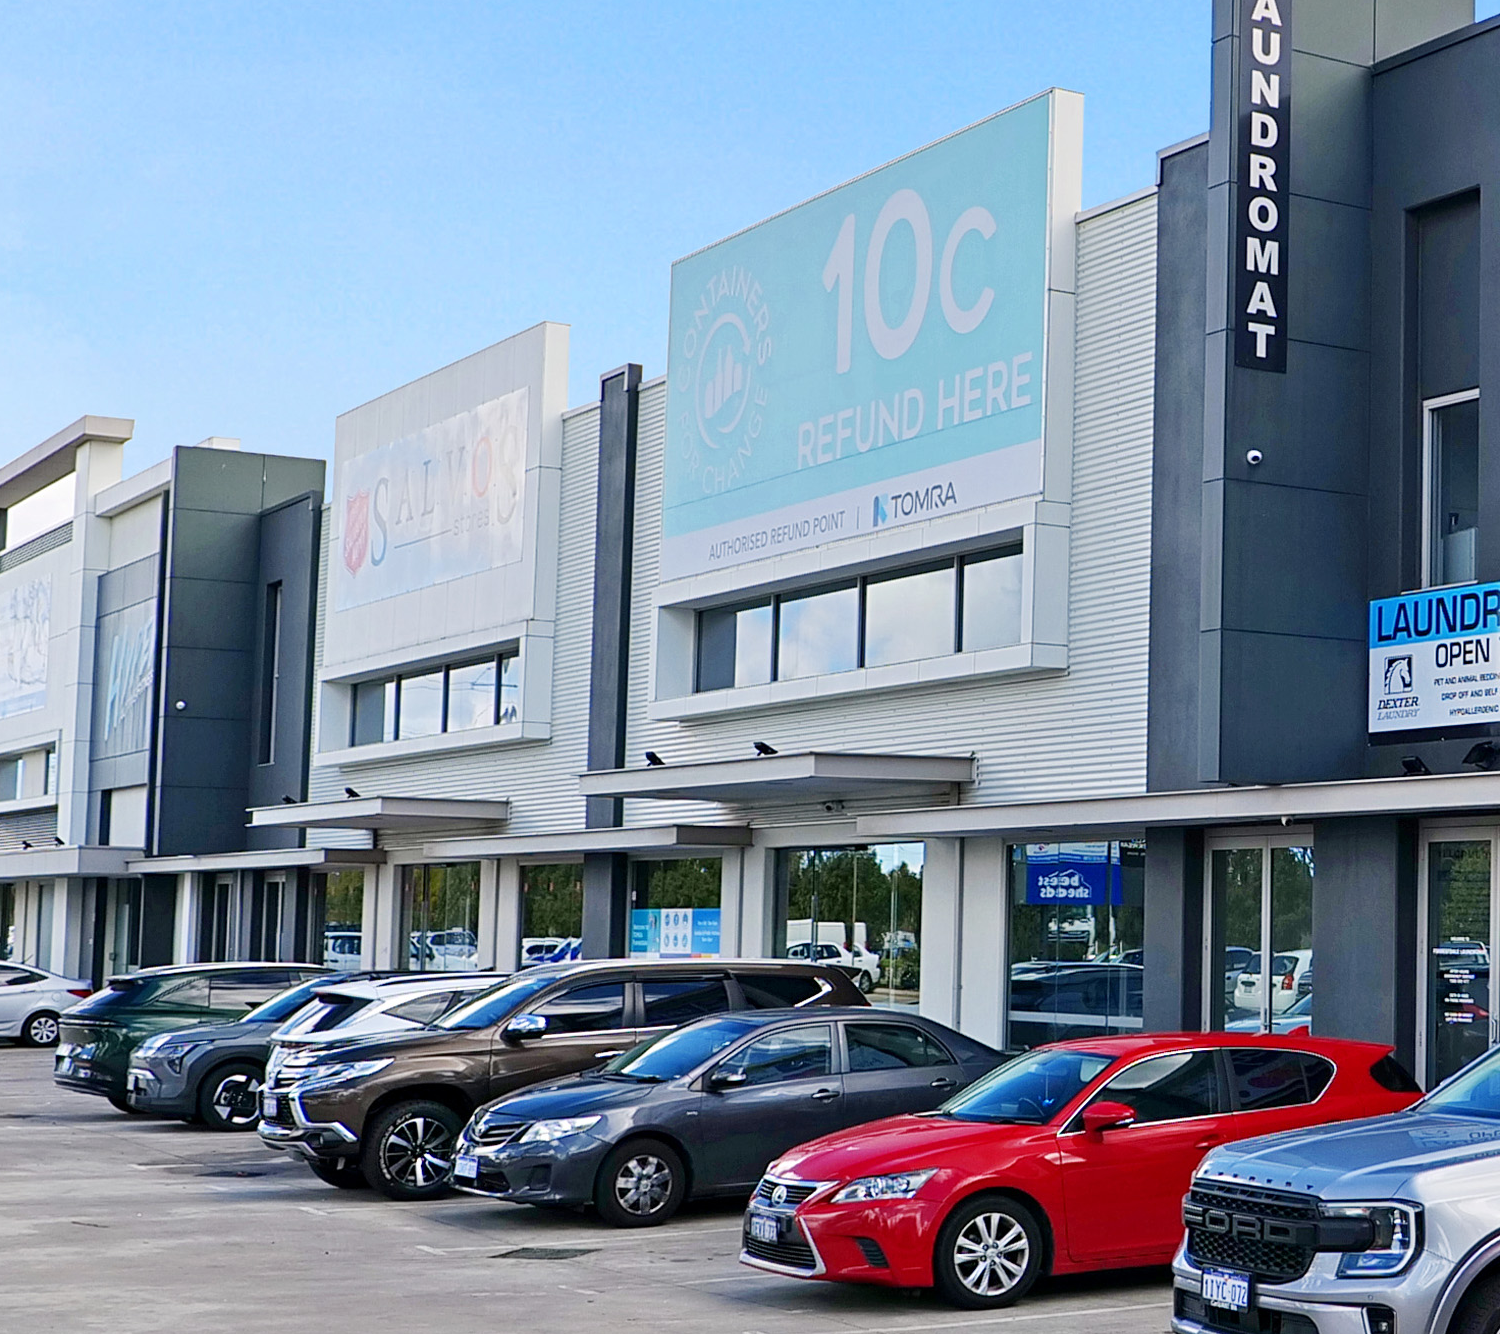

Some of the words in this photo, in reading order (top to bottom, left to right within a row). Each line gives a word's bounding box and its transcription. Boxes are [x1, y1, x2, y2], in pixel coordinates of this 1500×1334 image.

[680, 266, 772, 394] CONTAINERS
[799, 387, 925, 468] REFUND
[936, 351, 1033, 425] HERE
[702, 384, 768, 495] CHANGE
[891, 481, 958, 519] TOMRA
[708, 531, 768, 561] AUTHORISED
[770, 520, 811, 545] REFUND
[812, 510, 846, 535] POINT
[1435, 637, 1490, 668] OPEN
[1377, 696, 1420, 710] DEXTER
[1377, 708, 1420, 720] LAUNDRY
